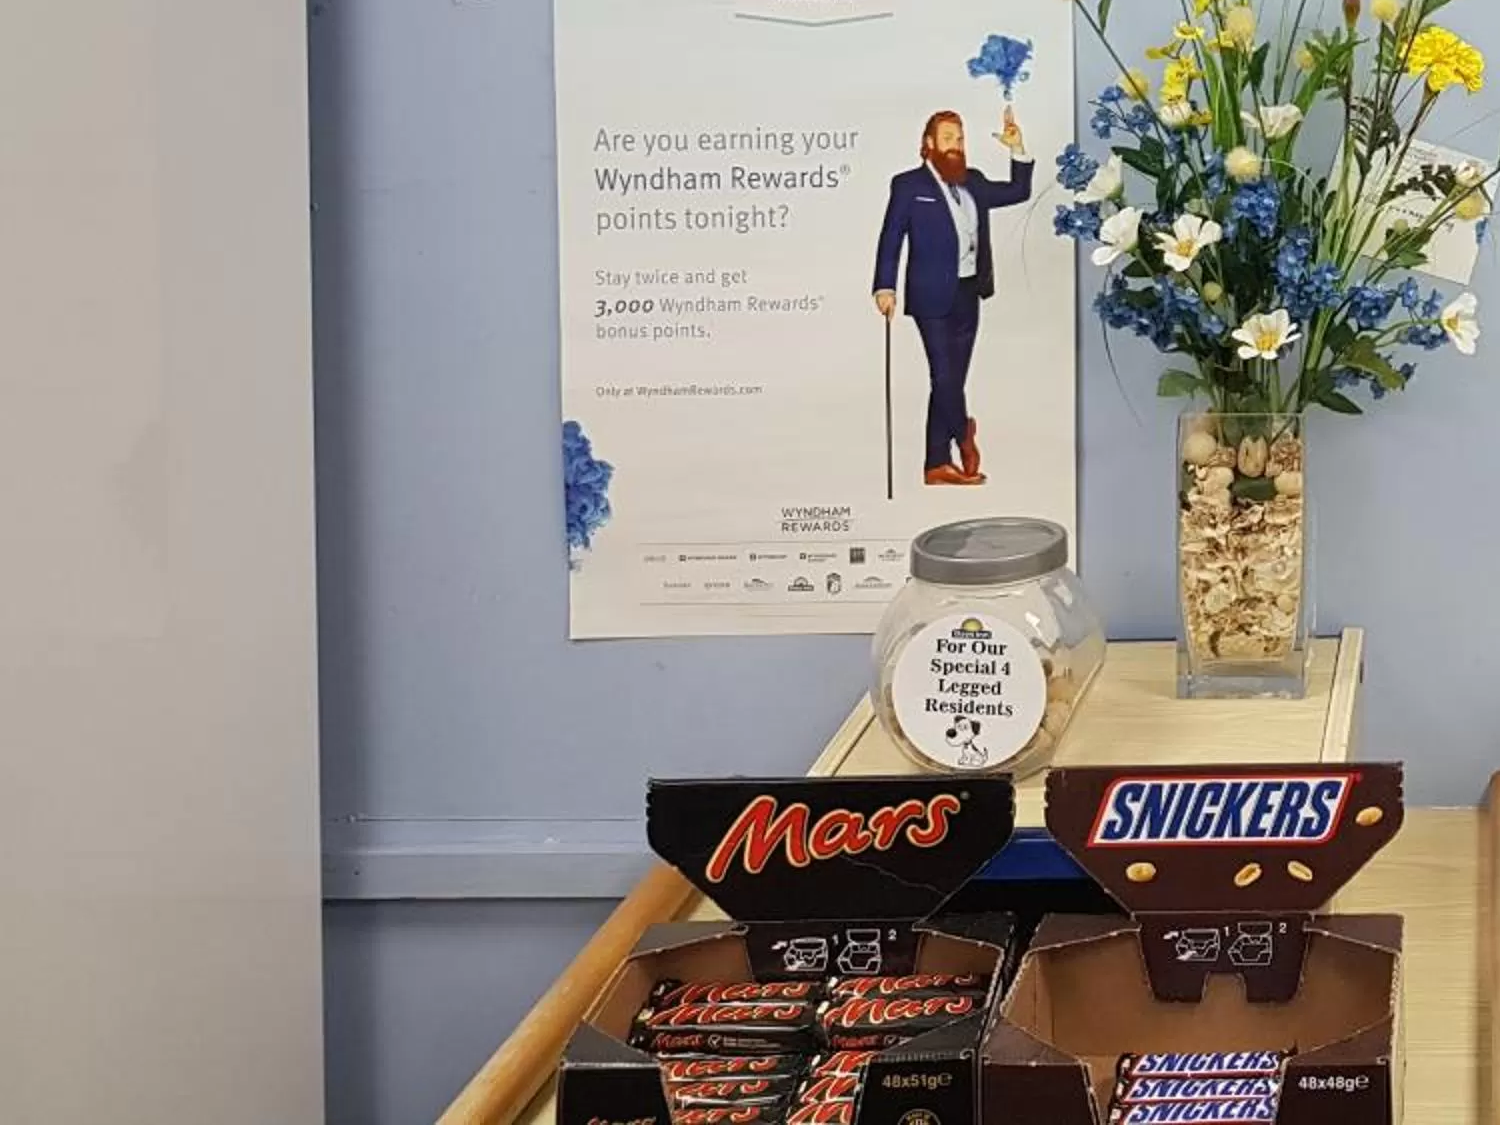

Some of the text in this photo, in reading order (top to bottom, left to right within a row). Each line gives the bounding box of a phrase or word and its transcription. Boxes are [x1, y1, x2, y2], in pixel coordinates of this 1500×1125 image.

[594, 127, 860, 156] Are you earning your
[594, 167, 721, 195] Wyndham
[597, 205, 789, 235] points tonight?
[595, 269, 748, 288] Stay twice and get
[594, 299, 655, 317] 3,000
[659, 297, 741, 315] Wyndham
[596, 324, 711, 341] bonus points.
[781, 506, 851, 518] WYNDHAM
[781, 521, 850, 533] REWARDS
[936, 638, 1007, 655] For Our
[930, 658, 1011, 677] Special 4
[938, 678, 1001, 697] Legged
[925, 698, 1013, 717] Residents
[1100, 780, 1343, 840] SNICKERS
[706, 795, 961, 883] Mars
[660, 982, 811, 1006] Mars
[646, 1003, 803, 1028] Mars
[823, 996, 974, 1028] Mars
[1138, 1052, 1281, 1073] SNICKERS
[669, 1079, 770, 1099] ars
[1130, 1077, 1280, 1099] SNICKERS
[1127, 1099, 1276, 1125] SNICKERS
